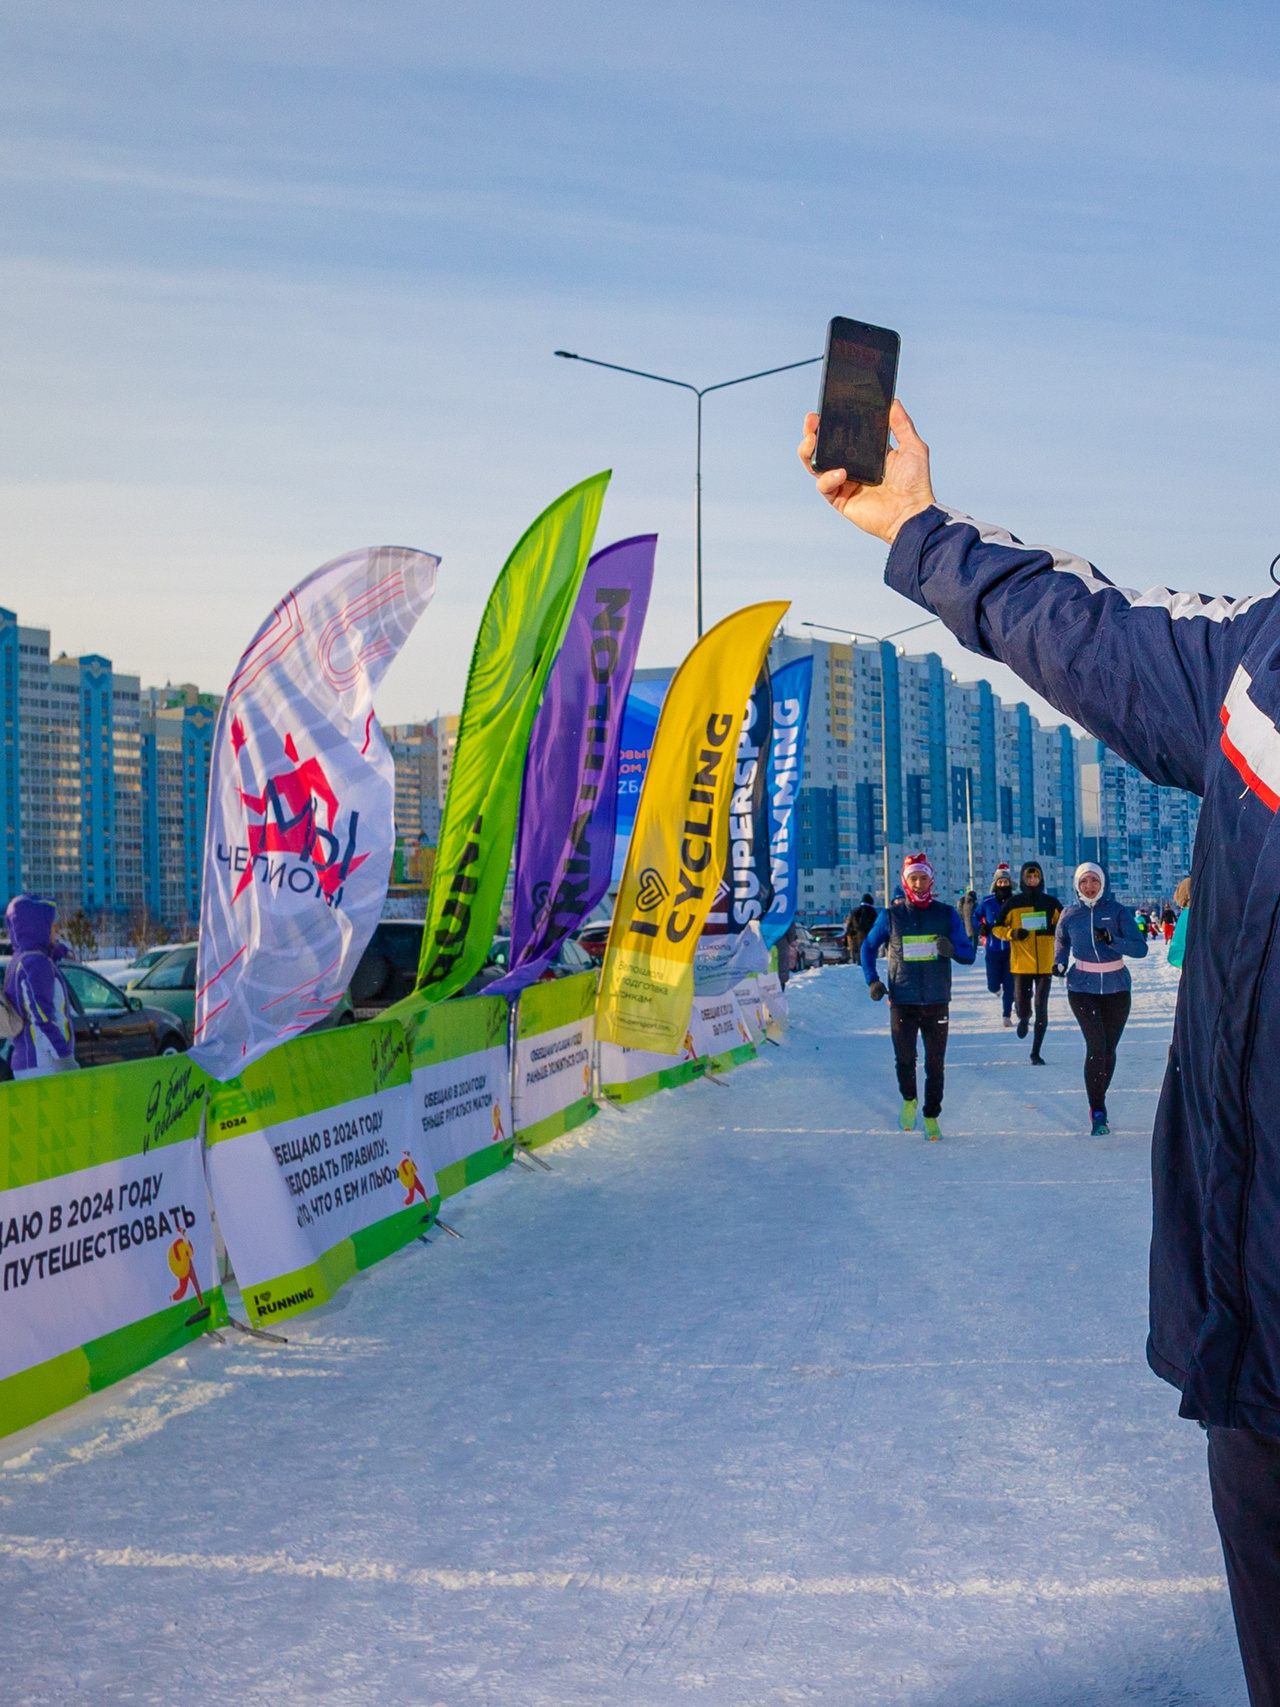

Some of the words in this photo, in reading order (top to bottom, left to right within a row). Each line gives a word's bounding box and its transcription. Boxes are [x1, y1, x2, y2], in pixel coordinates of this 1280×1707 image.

[258, 779, 359, 880] МЫ
[667, 713, 733, 943] CYCLING
[729, 686, 762, 925] SUPERSPO
[630, 920, 660, 938] I
[220, 1116, 247, 1130] 2024
[272, 1132, 321, 1166] БЕЩАЮ
[323, 1129, 332, 1149] В
[333, 1120, 358, 1146] 2024
[359, 1109, 383, 1135] ГОДУ
[421, 1111, 445, 1132] ЕНЬШЕ
[286, 1158, 340, 1196] ЕДОВАТЬ
[341, 1138, 390, 1173] ПРАВИЛУ:
[50, 1204, 63, 1234] В
[67, 1189, 114, 1229] 2024
[119, 1173, 163, 1211] ГОДУ
[310, 1192, 332, 1217] ЧТО
[335, 1187, 343, 1208] Я
[344, 1180, 359, 1203] ЕМ
[361, 1178, 368, 1196] И
[4, 1205, 196, 1291] ПУТЕШЕСТВОВАТЬ
[257, 1287, 314, 1317] RUNNING
